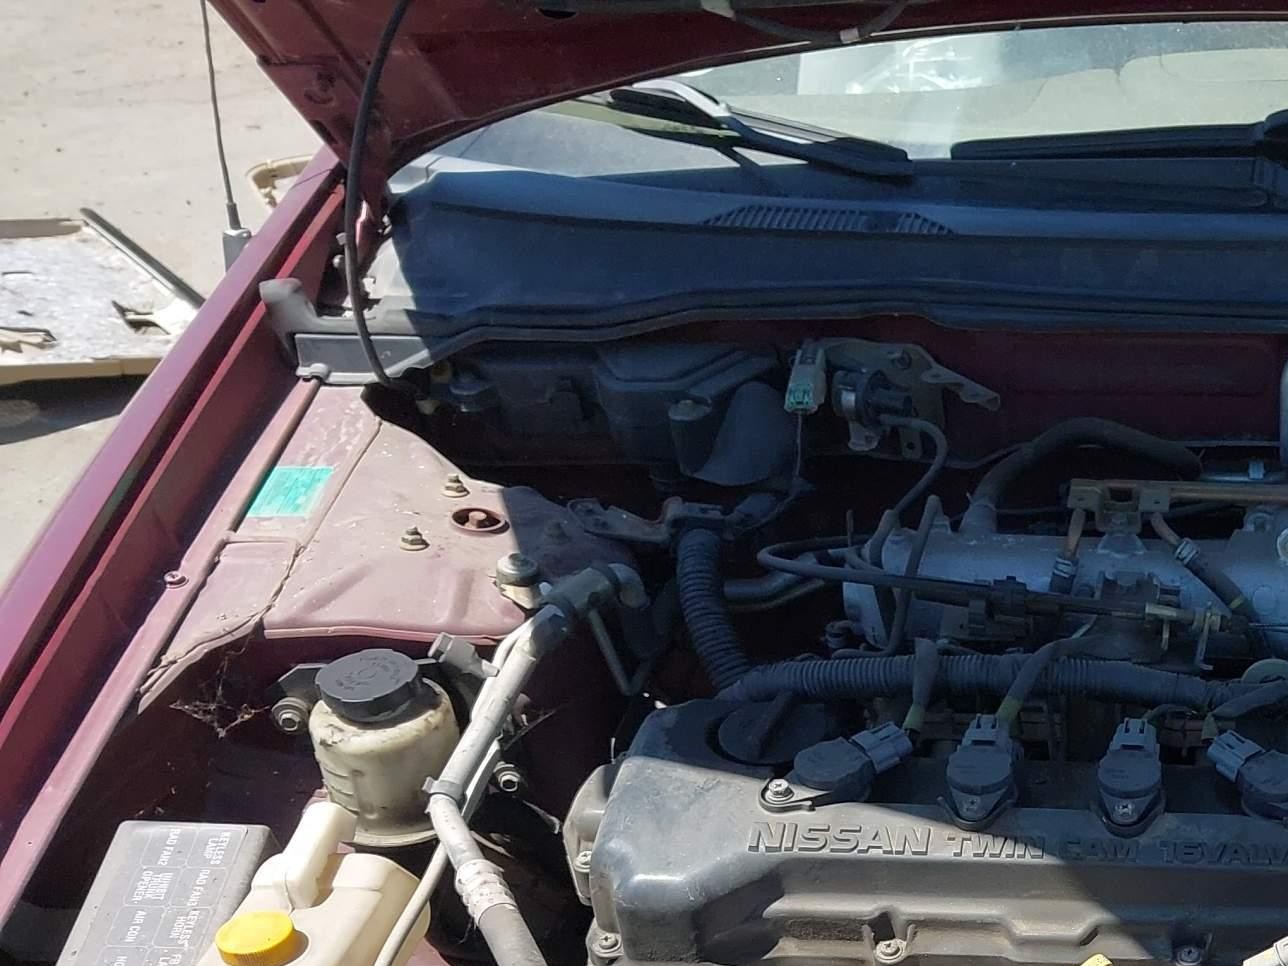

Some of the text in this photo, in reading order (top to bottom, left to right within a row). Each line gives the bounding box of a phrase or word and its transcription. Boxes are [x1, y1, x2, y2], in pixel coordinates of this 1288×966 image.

[166, 829, 181, 845] RAD
[748, 822, 931, 855] NISSAN
[947, 833, 1045, 859] TWIN
[1061, 838, 1139, 862] CAM
[204, 838, 219, 859] LAMP
[210, 832, 232, 865] KEYLESS
[195, 869, 210, 885] RAD
[134, 911, 147, 924] AIR
[169, 916, 187, 939] HORN
